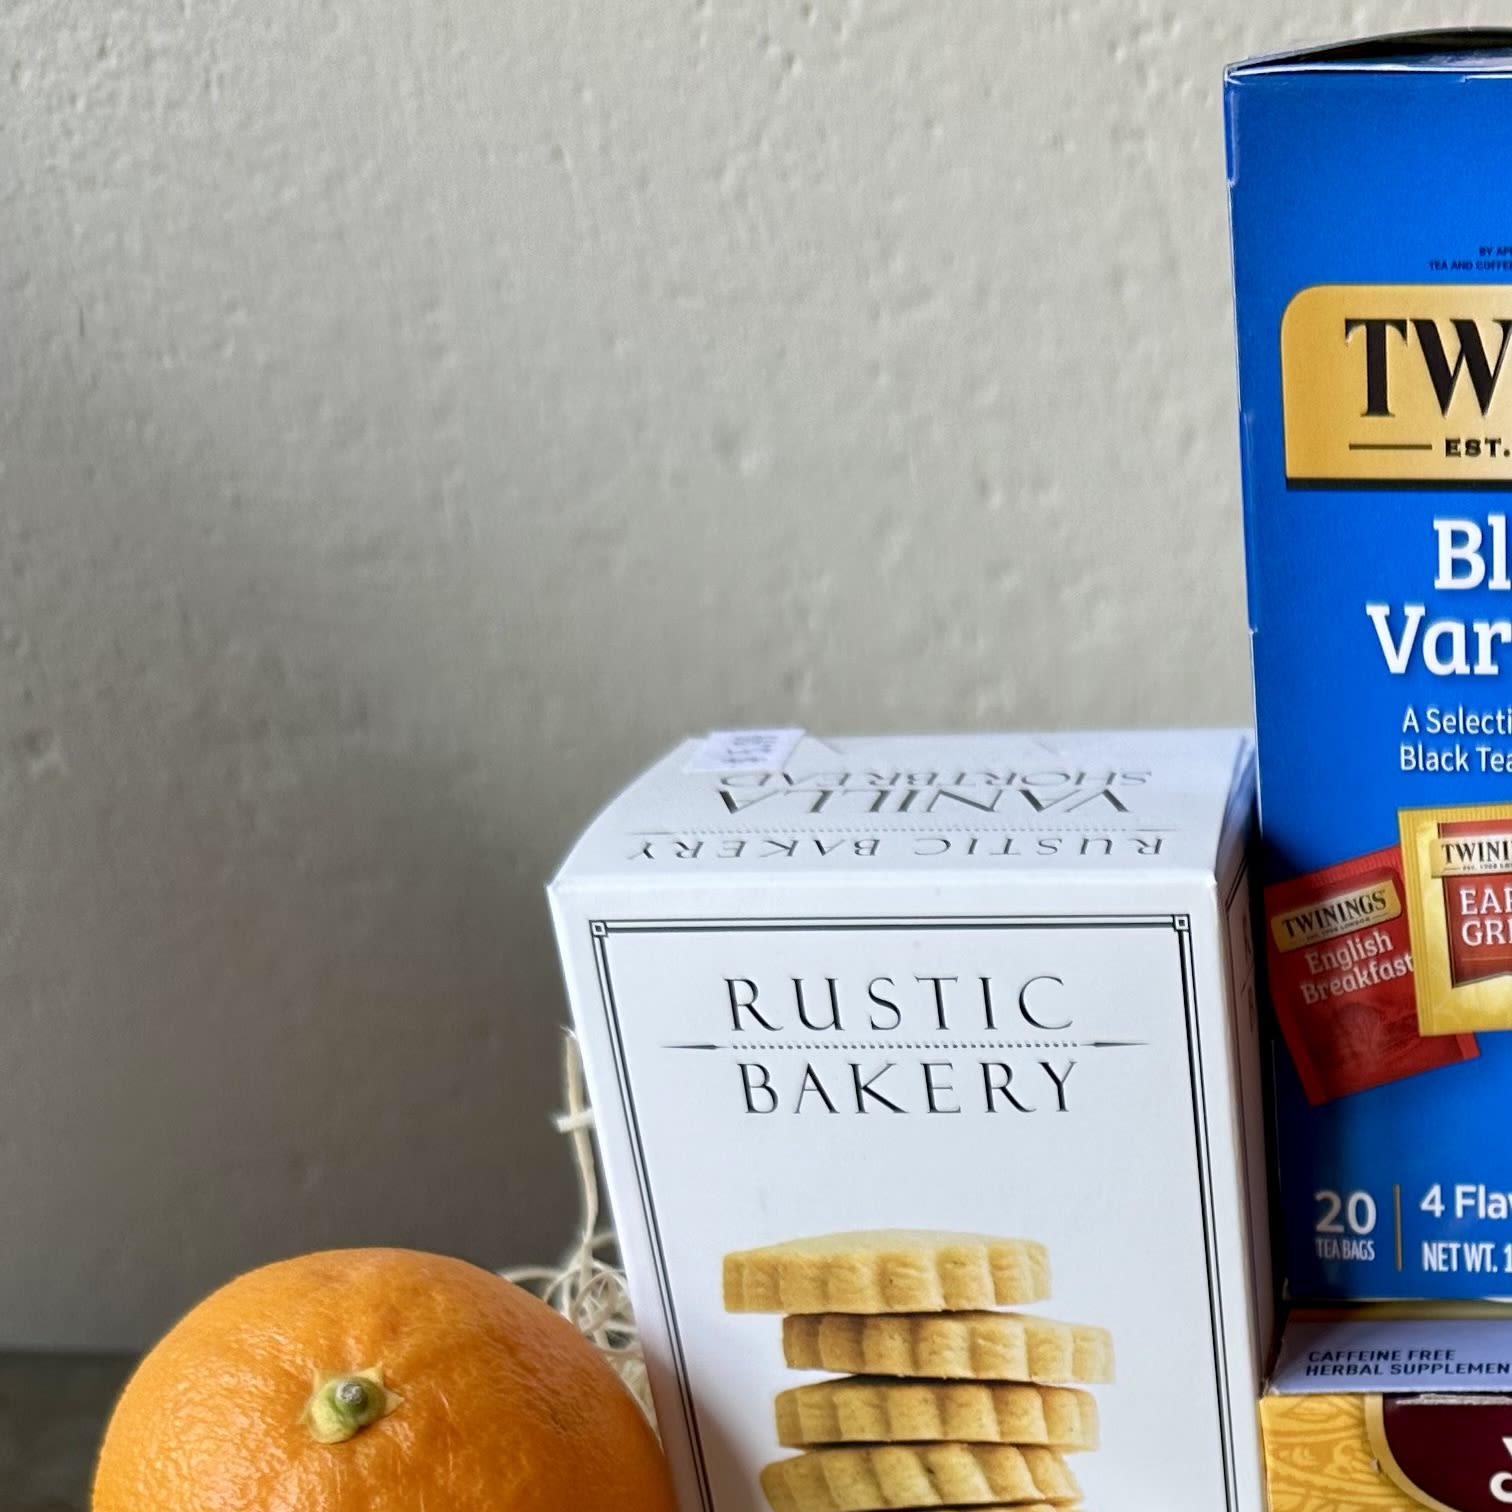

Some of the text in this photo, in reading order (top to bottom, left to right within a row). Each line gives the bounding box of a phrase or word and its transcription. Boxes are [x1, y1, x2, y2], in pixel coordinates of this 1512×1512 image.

[1444, 436, 1511, 459] EST.
[1402, 711, 1421, 734] A
[1400, 744, 1469, 772] Black
[719, 770, 1153, 790] SHORTBREAD
[718, 787, 1132, 814] VANILLA
[626, 837, 1164, 862] RUSTIC BAKERY
[1281, 889, 1387, 938] TWININGS
[1305, 927, 1394, 976] English
[1300, 955, 1414, 1005] Breakfast
[722, 974, 1074, 1033] RUSTIC
[737, 1058, 1077, 1116] BAKERY
[1315, 1190, 1377, 1237] 20
[1420, 1186, 1446, 1218] 4
[1314, 1237, 1376, 1262] TEA BAGS
[1421, 1242, 1460, 1273] NET
[1463, 1243, 1499, 1274] WT.
[1305, 1363, 1384, 1376] HERBAL
[1308, 1349, 1457, 1362] CAFFEINE FREE
